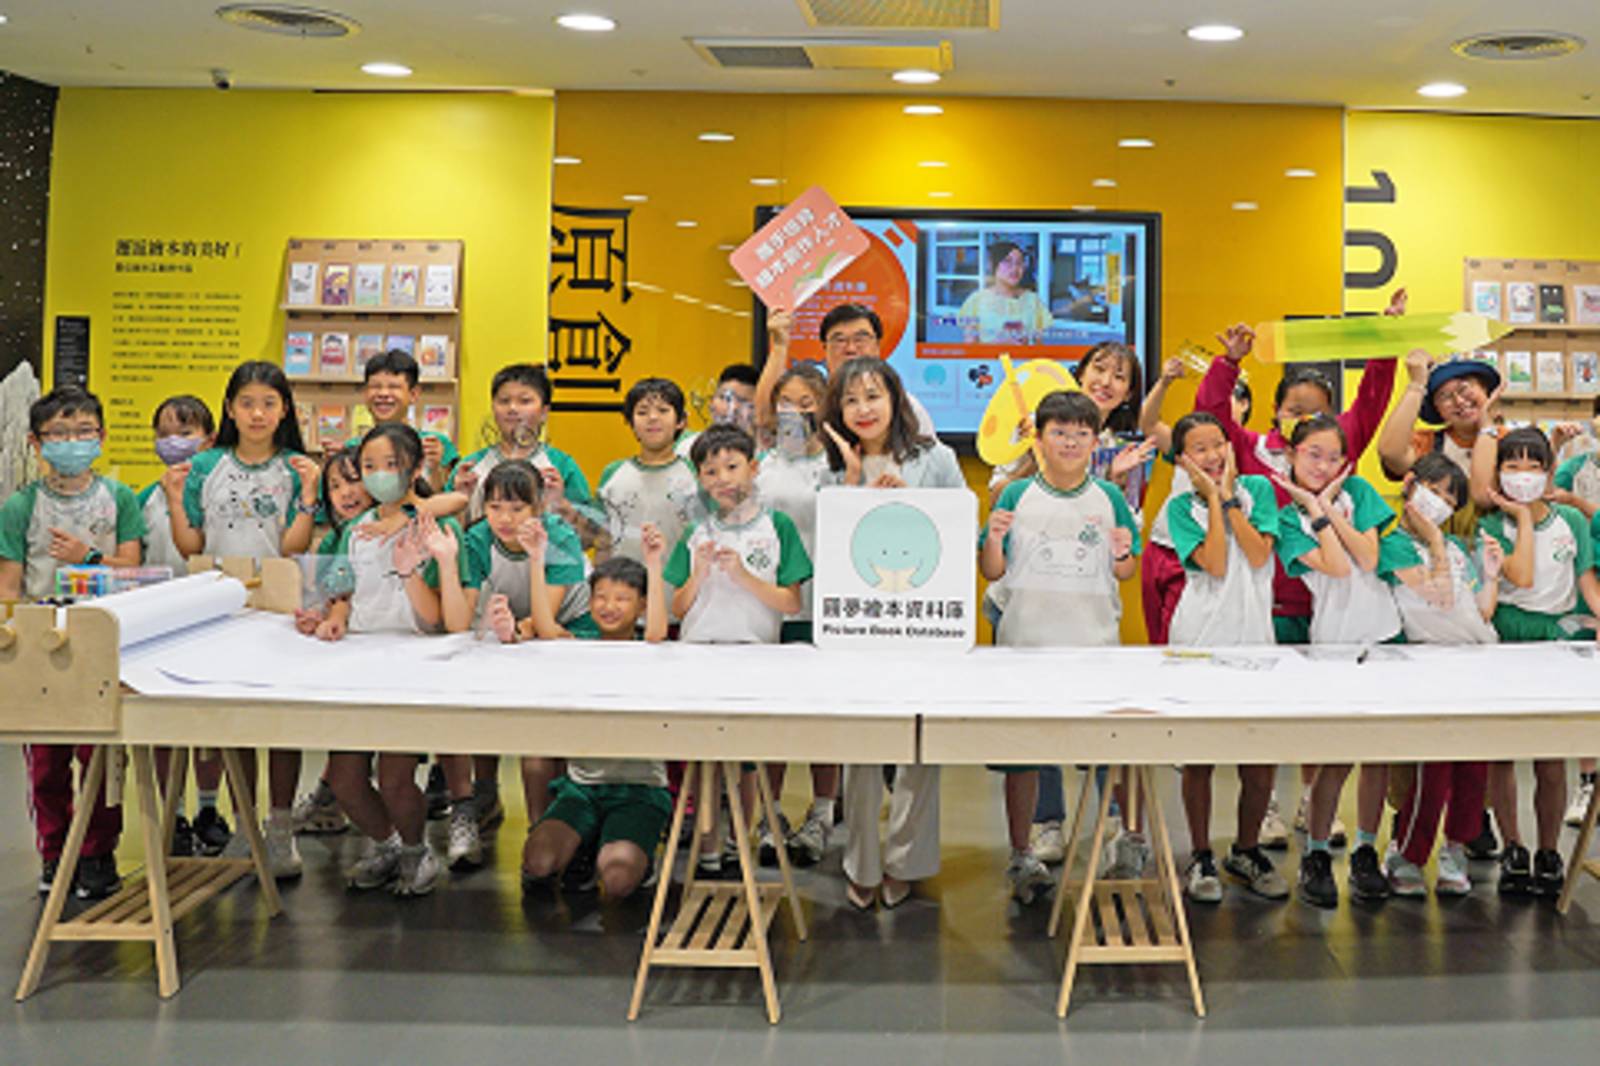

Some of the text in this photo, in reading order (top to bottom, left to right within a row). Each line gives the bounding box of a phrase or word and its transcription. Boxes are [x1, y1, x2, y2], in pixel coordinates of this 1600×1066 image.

[822, 597, 964, 619] 圓夢繪本資料庫
[822, 624, 965, 638] Picture Book Database
